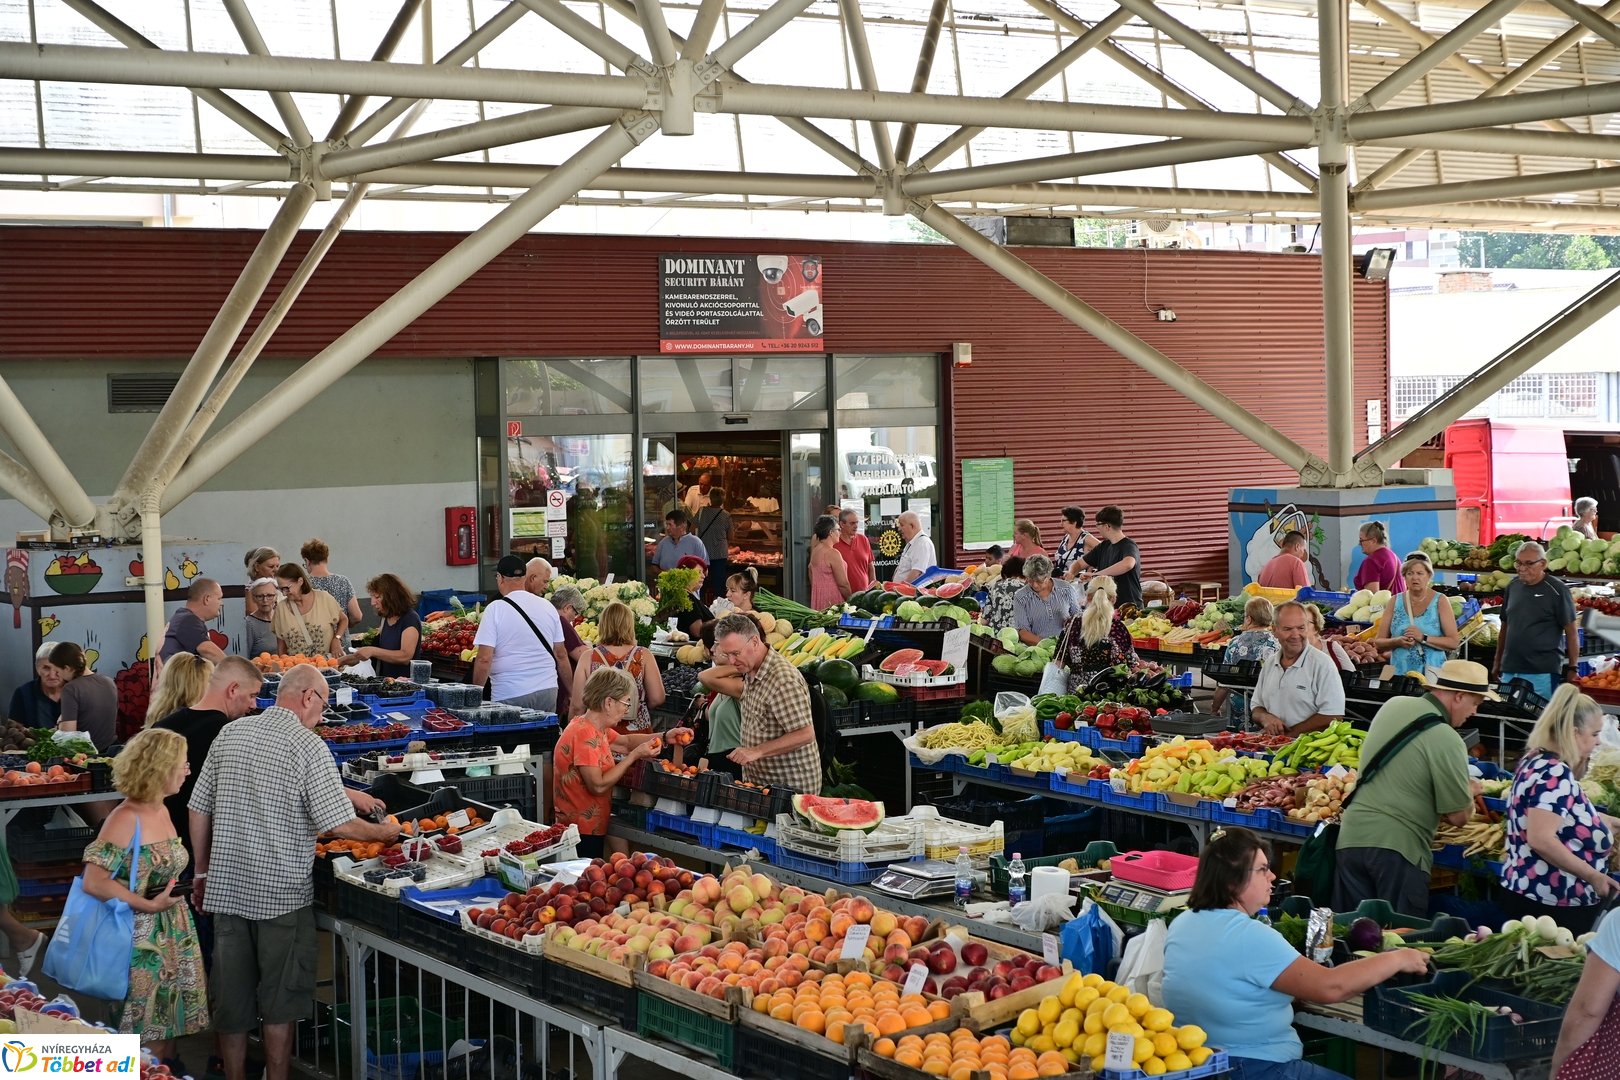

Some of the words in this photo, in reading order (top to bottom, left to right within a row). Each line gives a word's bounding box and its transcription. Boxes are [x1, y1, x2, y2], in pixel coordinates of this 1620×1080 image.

[665, 258, 745, 274] DOMINANT
[664, 277, 708, 287] SECURITY
[710, 275, 745, 287] BÁRÁNY
[664, 293, 739, 301] KAMERARENDSZERREL,
[664, 301, 698, 309] KIVONULÓ
[699, 301, 760, 309] AKCIÓCSOPORTTAL
[665, 309, 674, 317] ÉS
[674, 309, 695, 317] VIDEÓ
[696, 309, 764, 317] PORTASZOLGÁLATTAL
